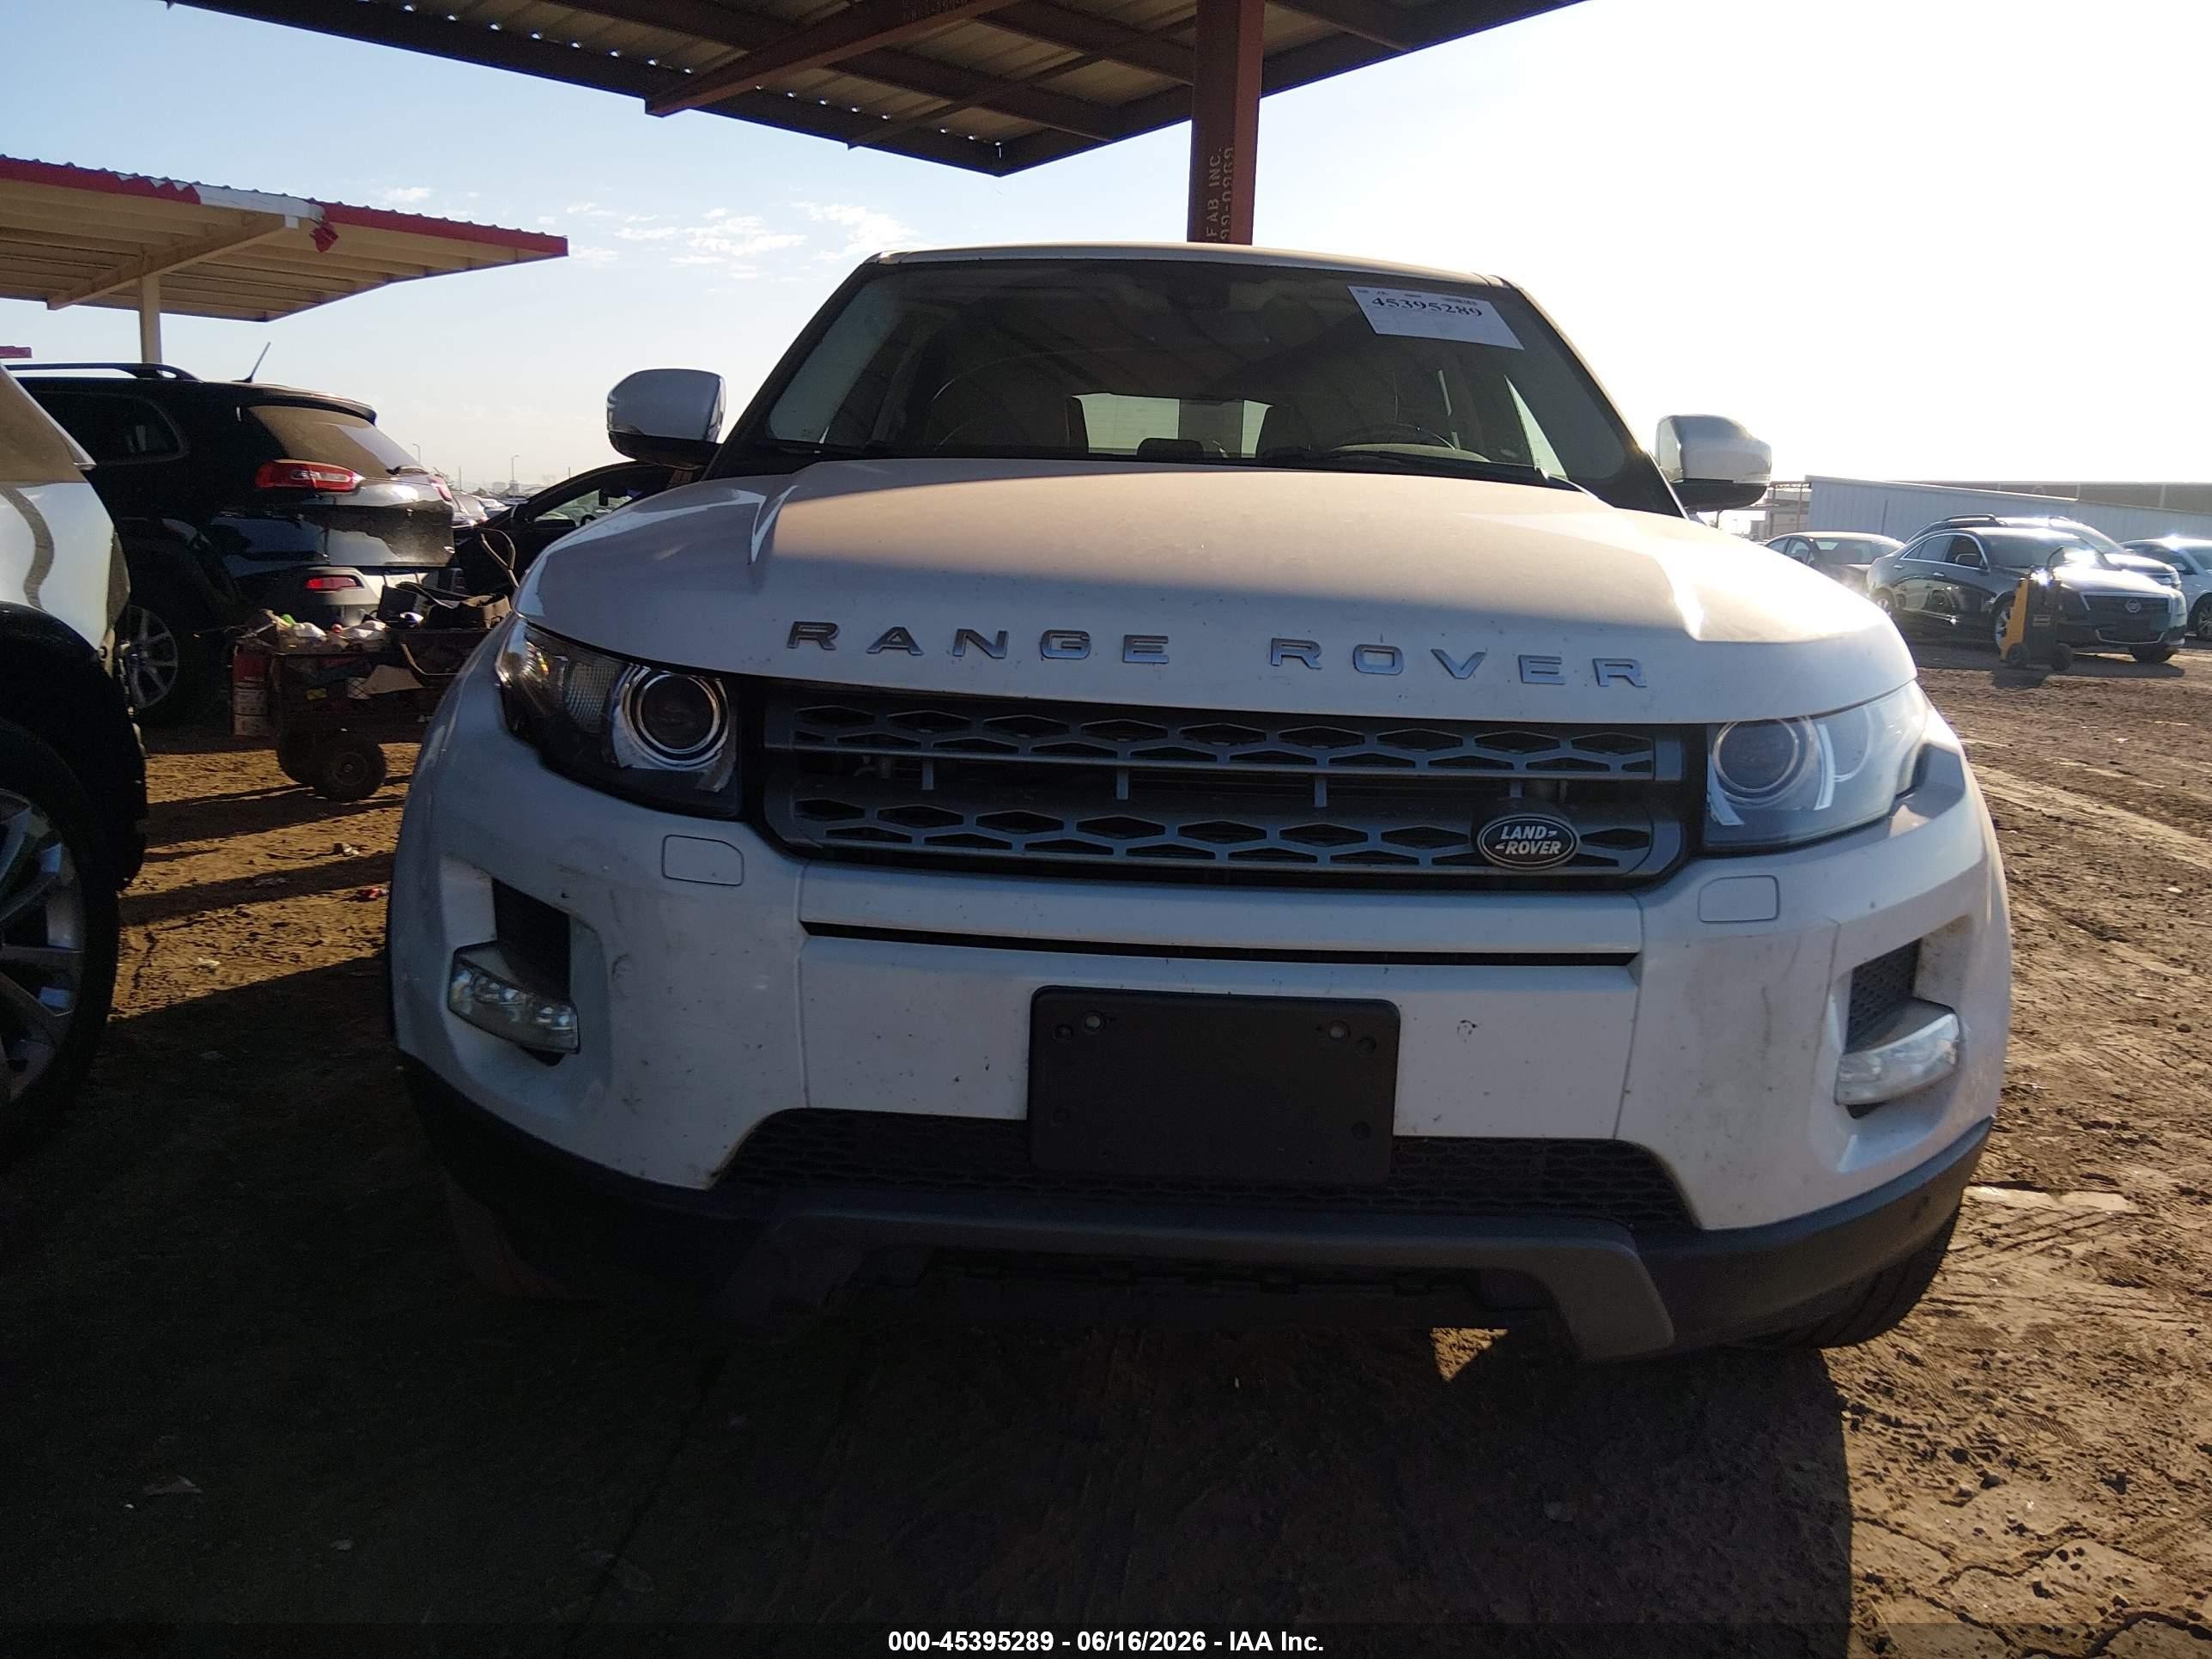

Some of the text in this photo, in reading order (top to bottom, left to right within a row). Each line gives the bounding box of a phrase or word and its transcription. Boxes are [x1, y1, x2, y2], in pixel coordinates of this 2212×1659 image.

[1206, 147, 1222, 237] FAB INC.
[1371, 297, 1483, 317] 45395289
[787, 621, 1648, 688] RANGE ROVER
[1500, 825, 1547, 840] LAND
[1504, 841, 1562, 854] ROVER
